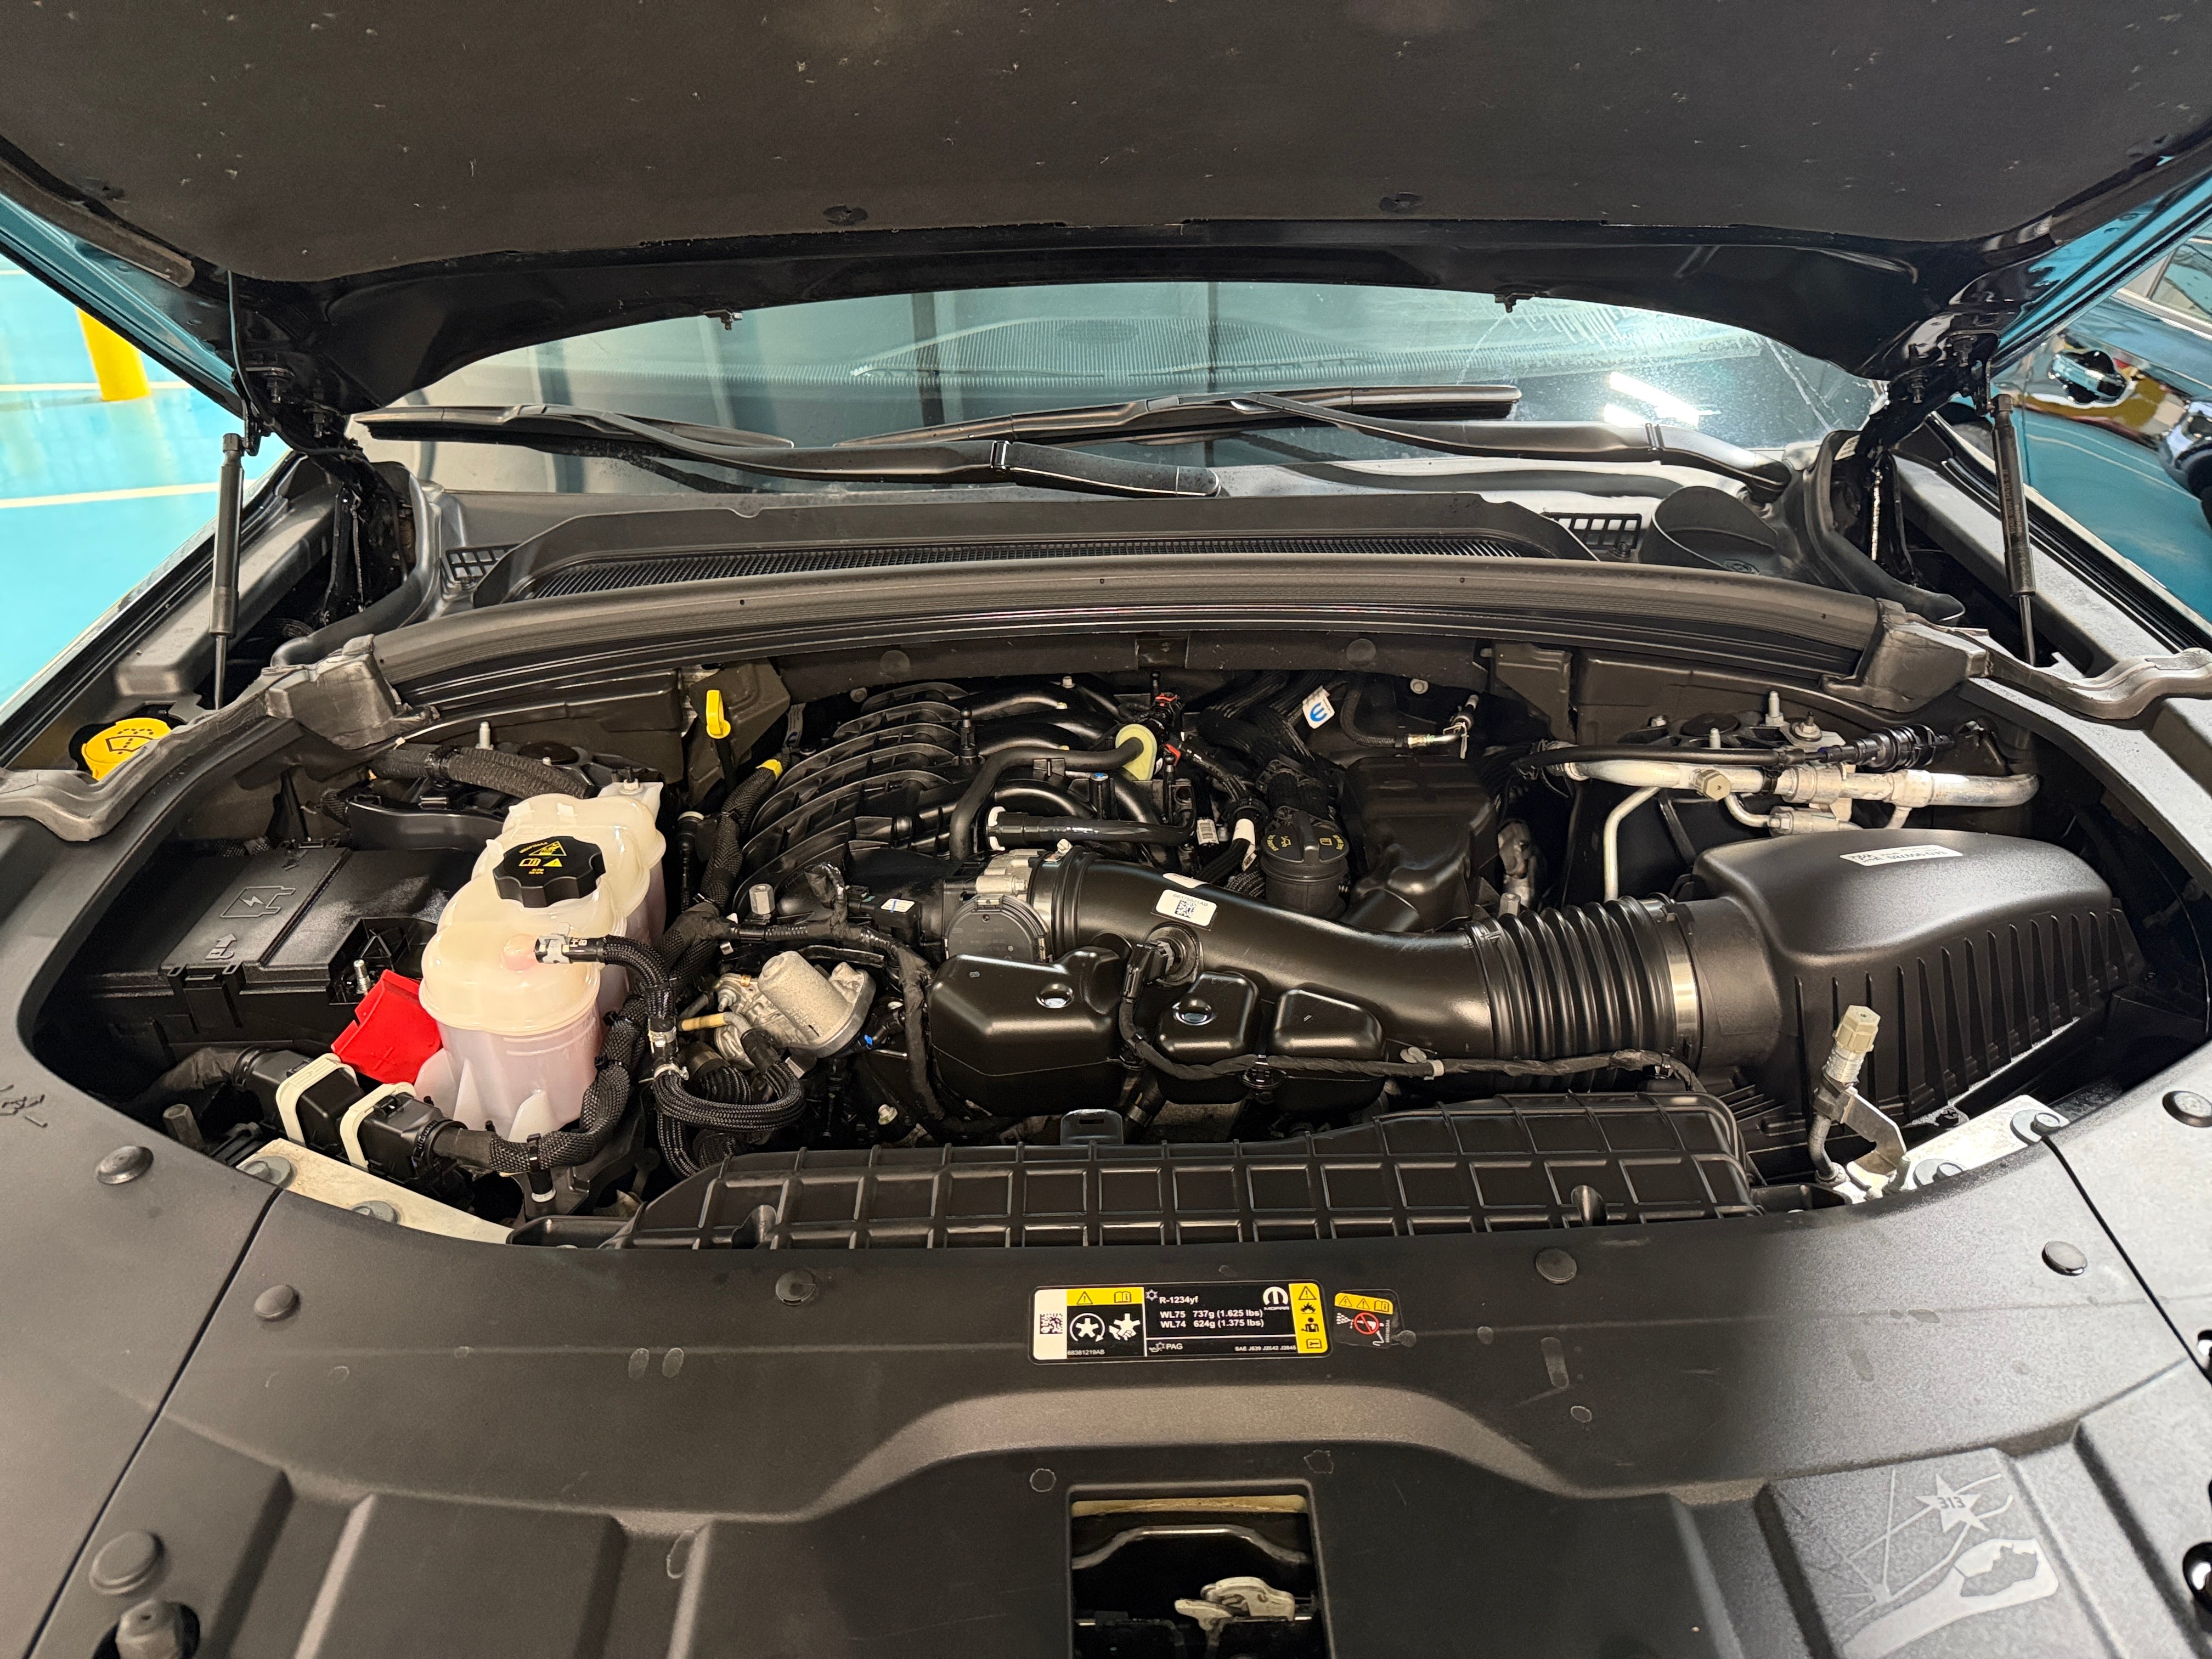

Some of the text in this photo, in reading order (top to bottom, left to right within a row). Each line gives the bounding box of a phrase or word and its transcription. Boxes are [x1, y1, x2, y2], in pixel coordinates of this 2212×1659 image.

[1159, 1296, 1199, 1305] R-1234yf
[1193, 1310, 1215, 1319] 737g
[1217, 1309, 1244, 1318] (1.625
[1245, 1309, 1263, 1318] lbs)
[1160, 1319, 1264, 1329] WL74 624g (1.375 lbs)
[1937, 1496, 1966, 1509] 313
